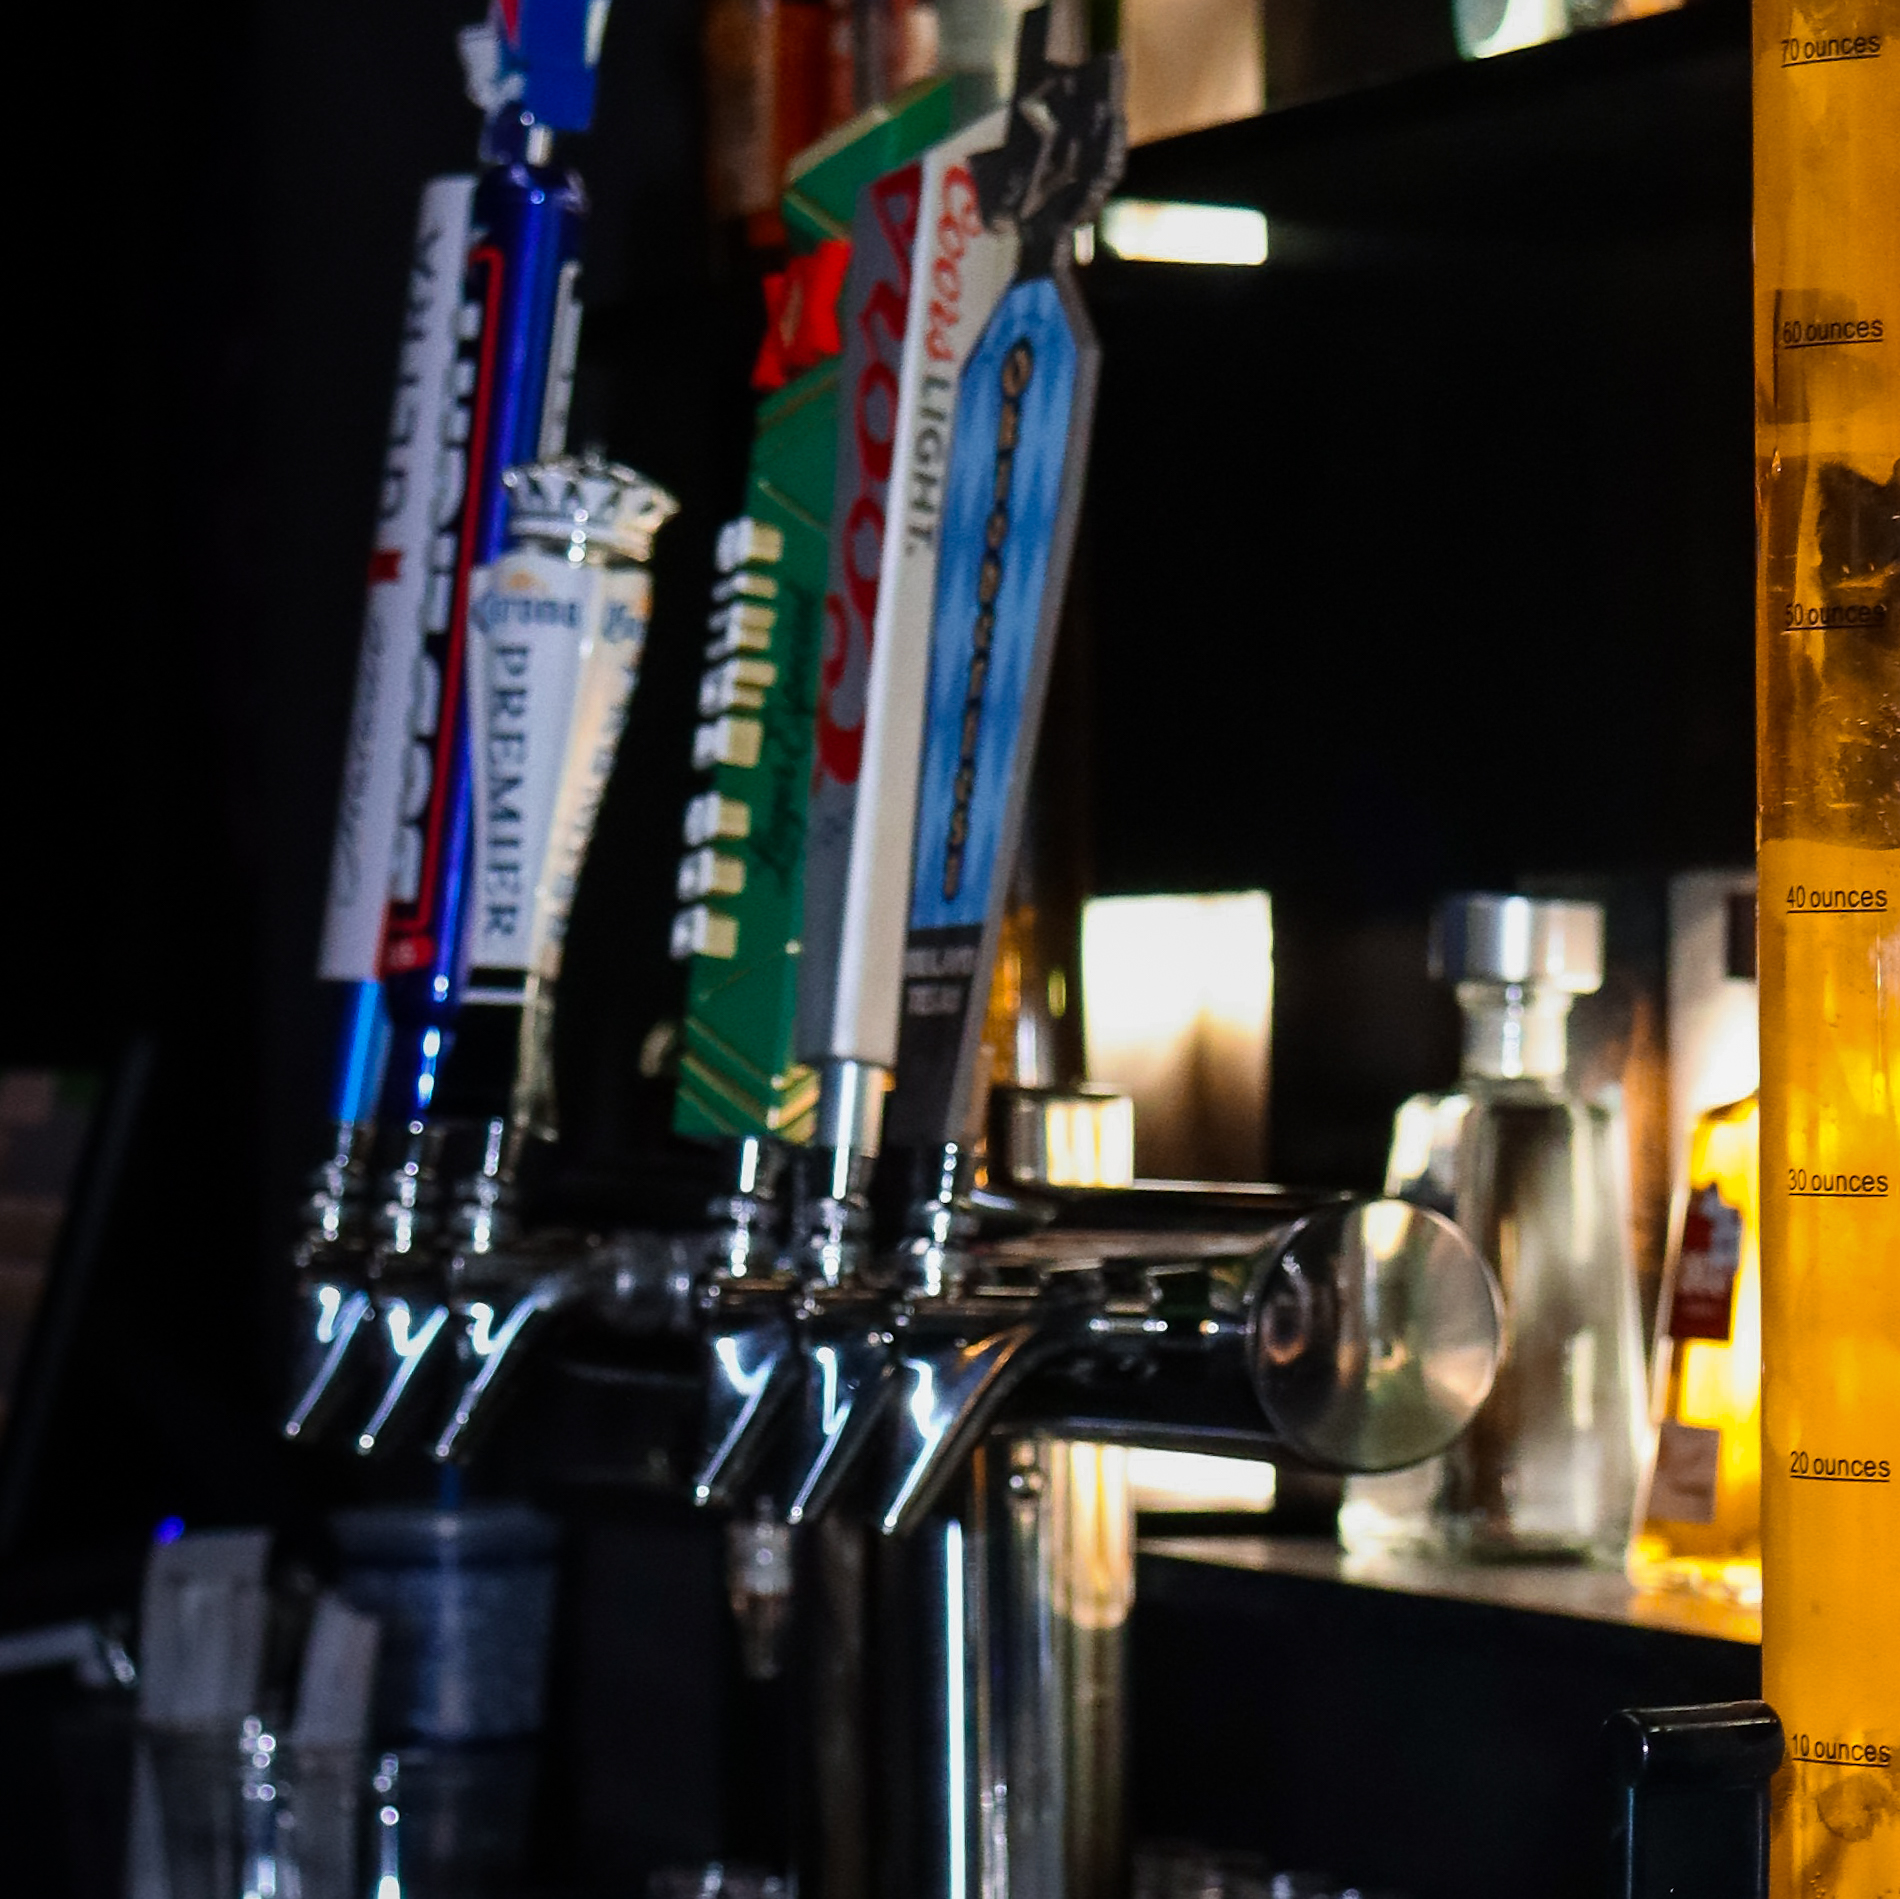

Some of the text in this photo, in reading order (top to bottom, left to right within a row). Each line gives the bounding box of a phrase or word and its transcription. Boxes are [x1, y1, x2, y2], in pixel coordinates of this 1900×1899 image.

[1781, 35, 1881, 61] 70 ounces
[925, 165, 984, 361] Coors
[1783, 319, 1883, 343] 60 ounces
[1785, 603, 1803, 625] 50
[488, 646, 528, 936] PREMIER
[1787, 885, 1887, 908] 40 ounces
[1788, 1169, 1888, 1192] 30 ounces
[1790, 1451, 1891, 1477] 20 ounces
[1792, 1734, 1891, 1762] 10 ounces
